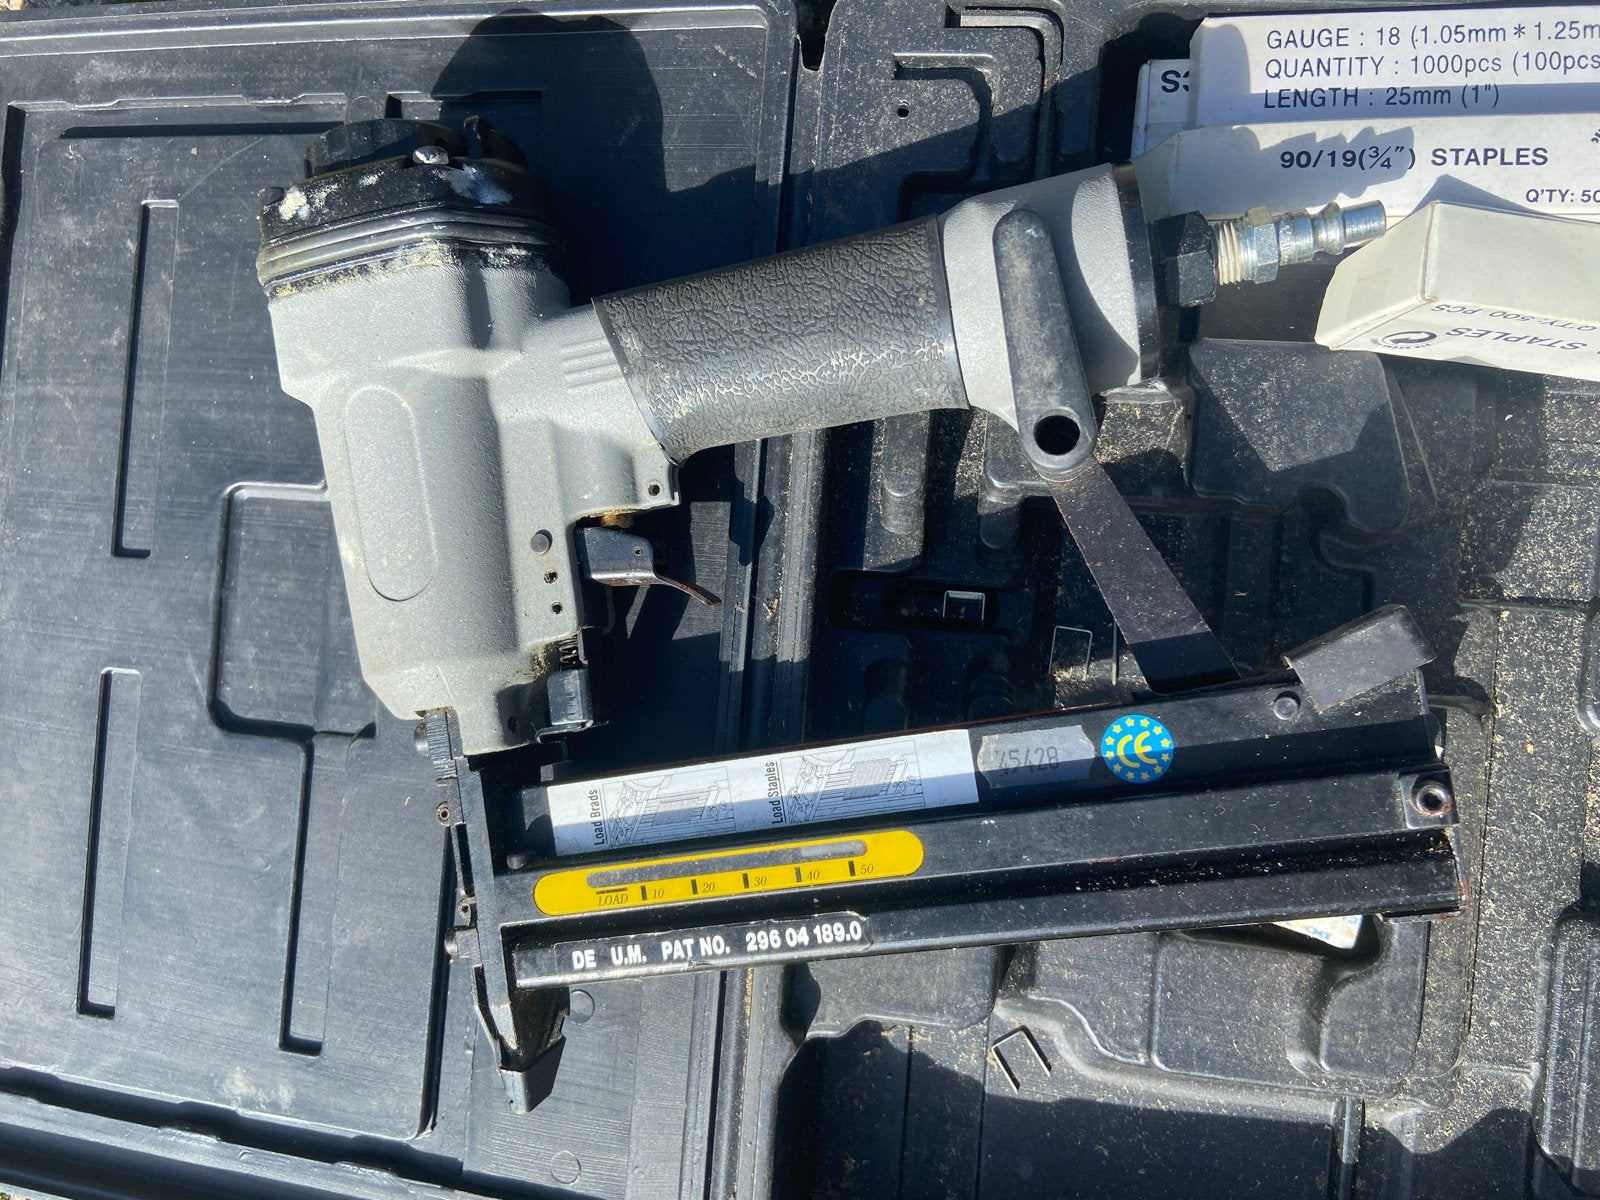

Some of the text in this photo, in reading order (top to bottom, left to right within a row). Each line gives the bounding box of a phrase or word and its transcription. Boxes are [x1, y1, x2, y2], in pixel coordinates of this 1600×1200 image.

[1267, 28, 1349, 49] GAUGE
[1377, 27, 1400, 46] 18
[1265, 56, 1384, 79] QUANTITY
[1411, 55, 1502, 78] 1000pcs
[1264, 87, 1359, 109] LENGTH
[1385, 86, 1451, 106] 25mm
[1431, 147, 1548, 166] STAPLES
[1431, 304, 1483, 315] PCS
[1489, 311, 1536, 322] 500
[1445, 327, 1588, 350] STAPLES
[1117, 731, 1157, 768] CE
[765, 762, 784, 824] Load Staples
[589, 789, 606, 845] Load Brads
[598, 864, 874, 906] LOAD 10 20 30 40 50
[572, 921, 862, 970] DE U.M. PAT NO. 296 04 189.0
